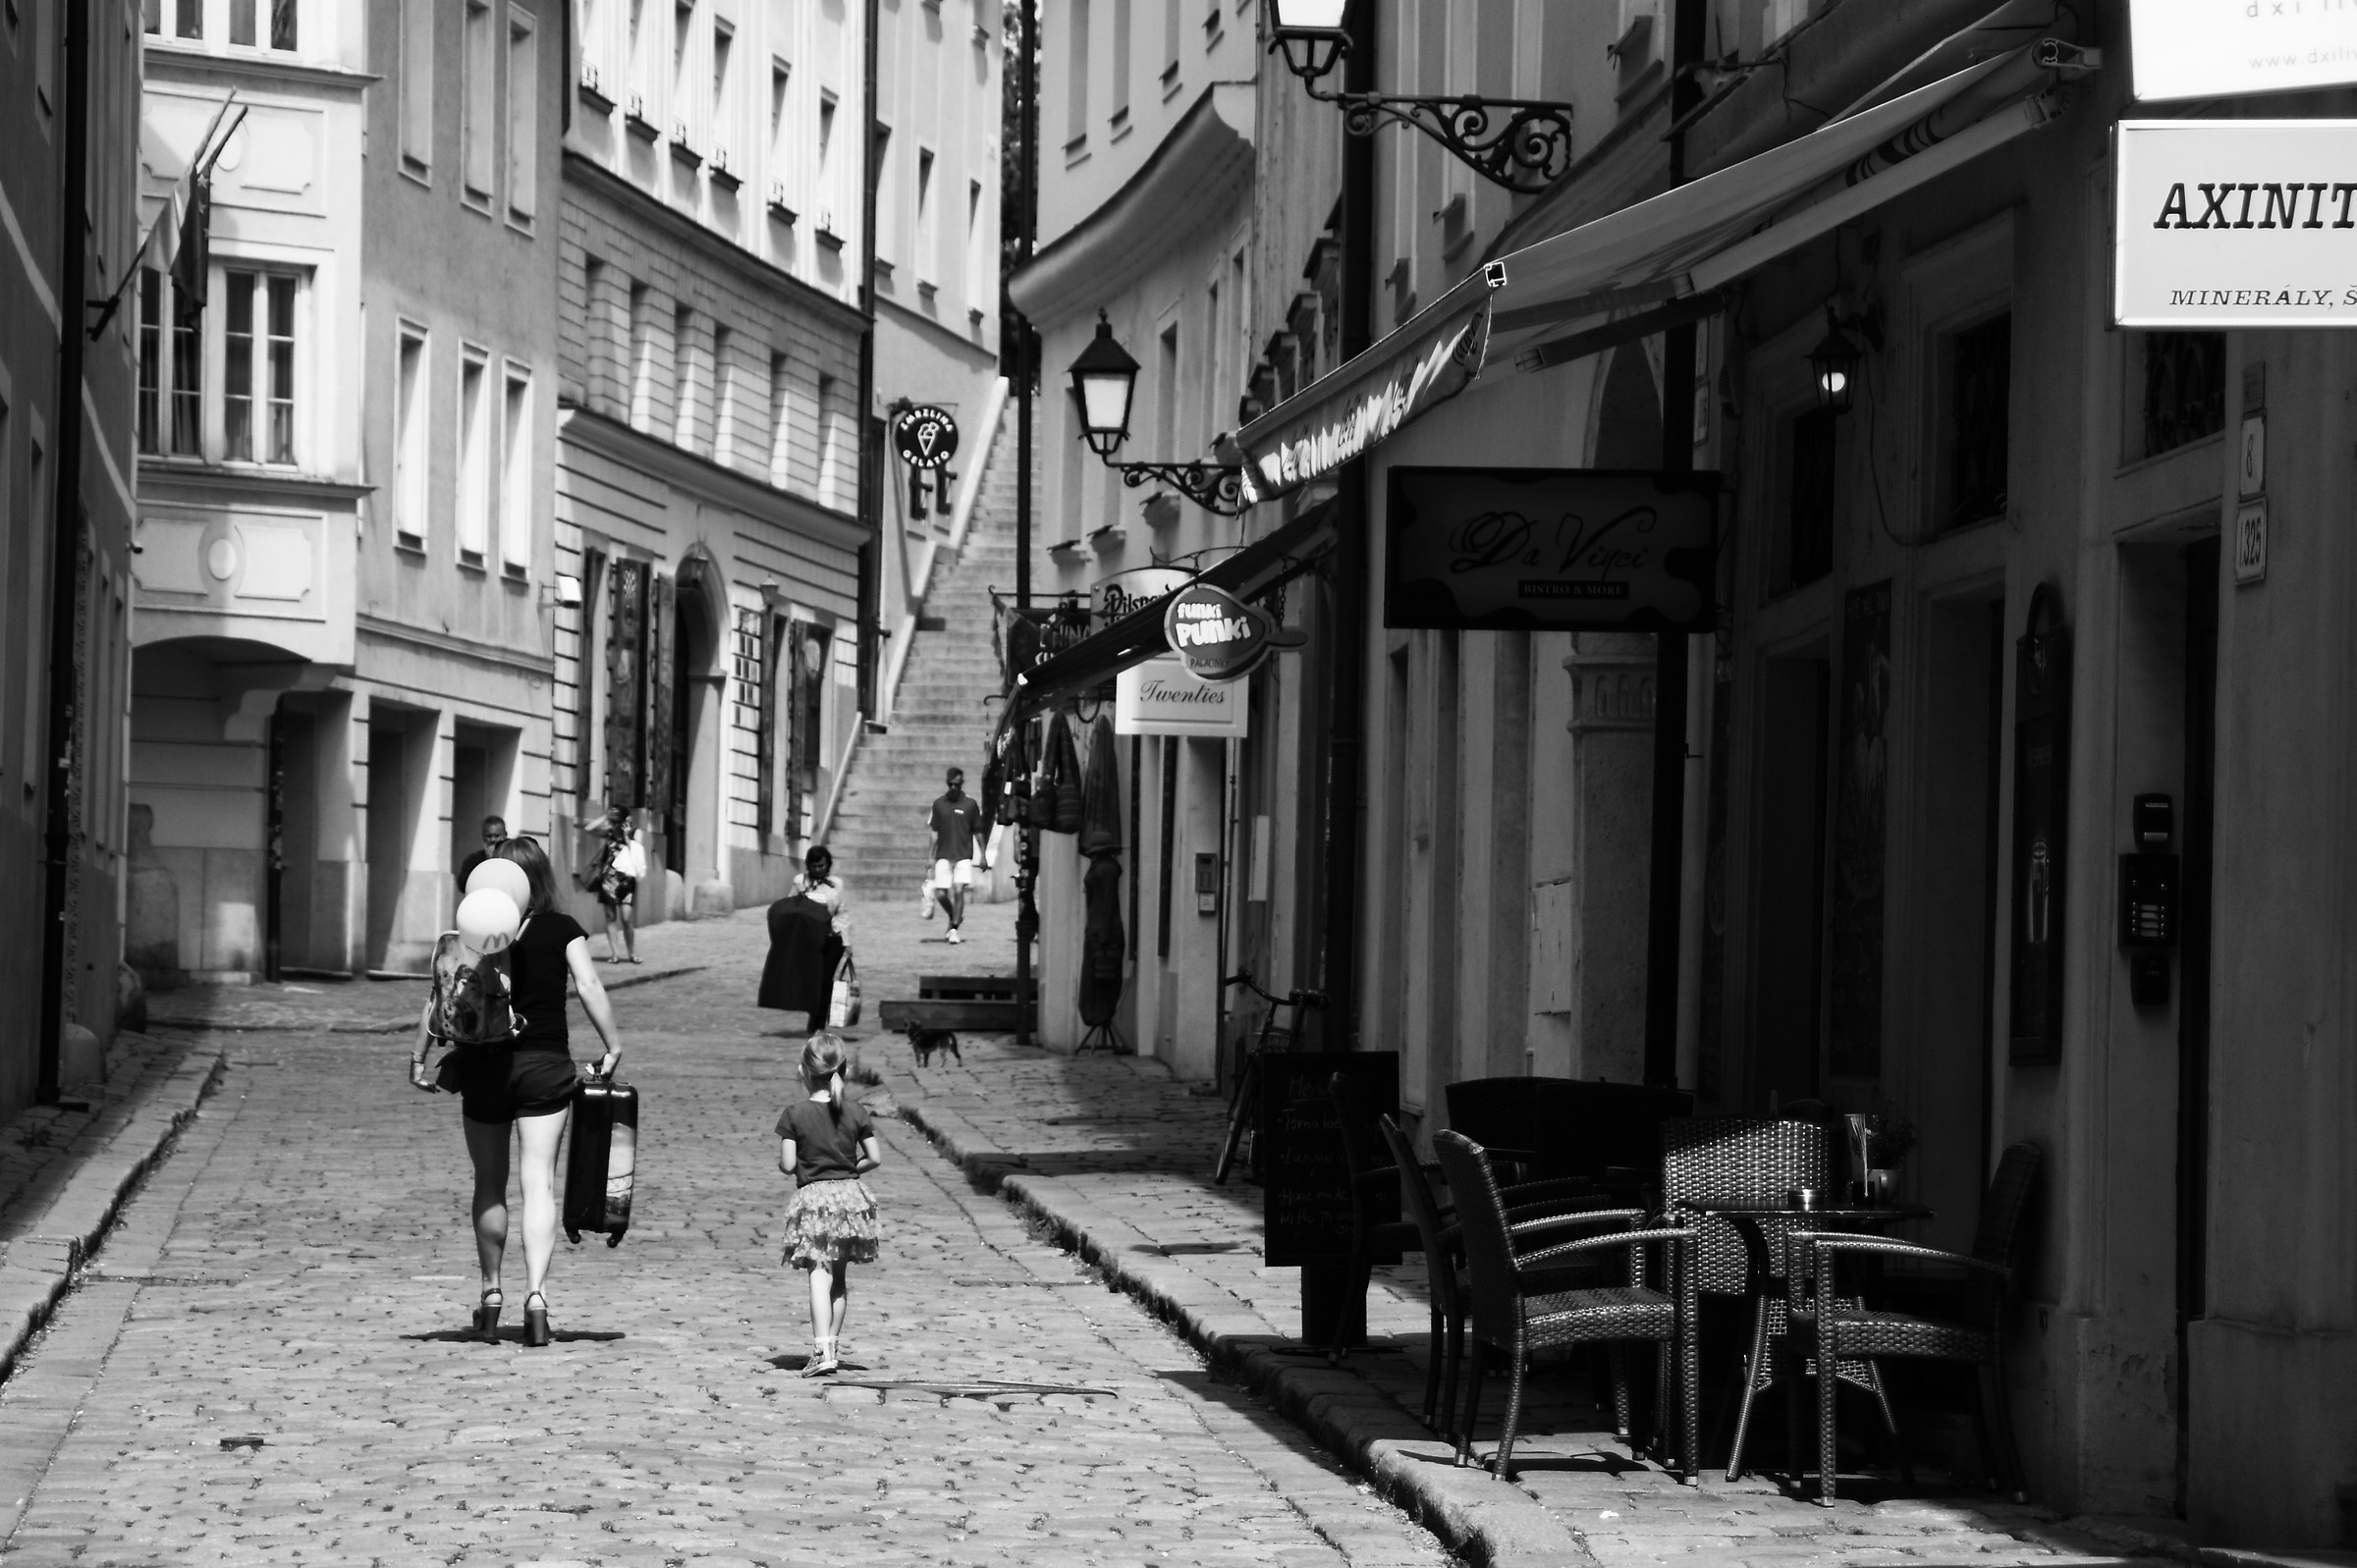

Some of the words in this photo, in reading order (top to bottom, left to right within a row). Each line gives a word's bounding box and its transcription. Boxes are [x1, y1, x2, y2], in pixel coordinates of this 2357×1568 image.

[1448, 511, 1540, 573] Da
[1555, 505, 1658, 581] Vinci
[1523, 583, 1570, 595] BISTRO
[1573, 584, 1582, 595] &
[1586, 584, 1622, 596] MORE
[1140, 679, 1225, 704] Twenties
